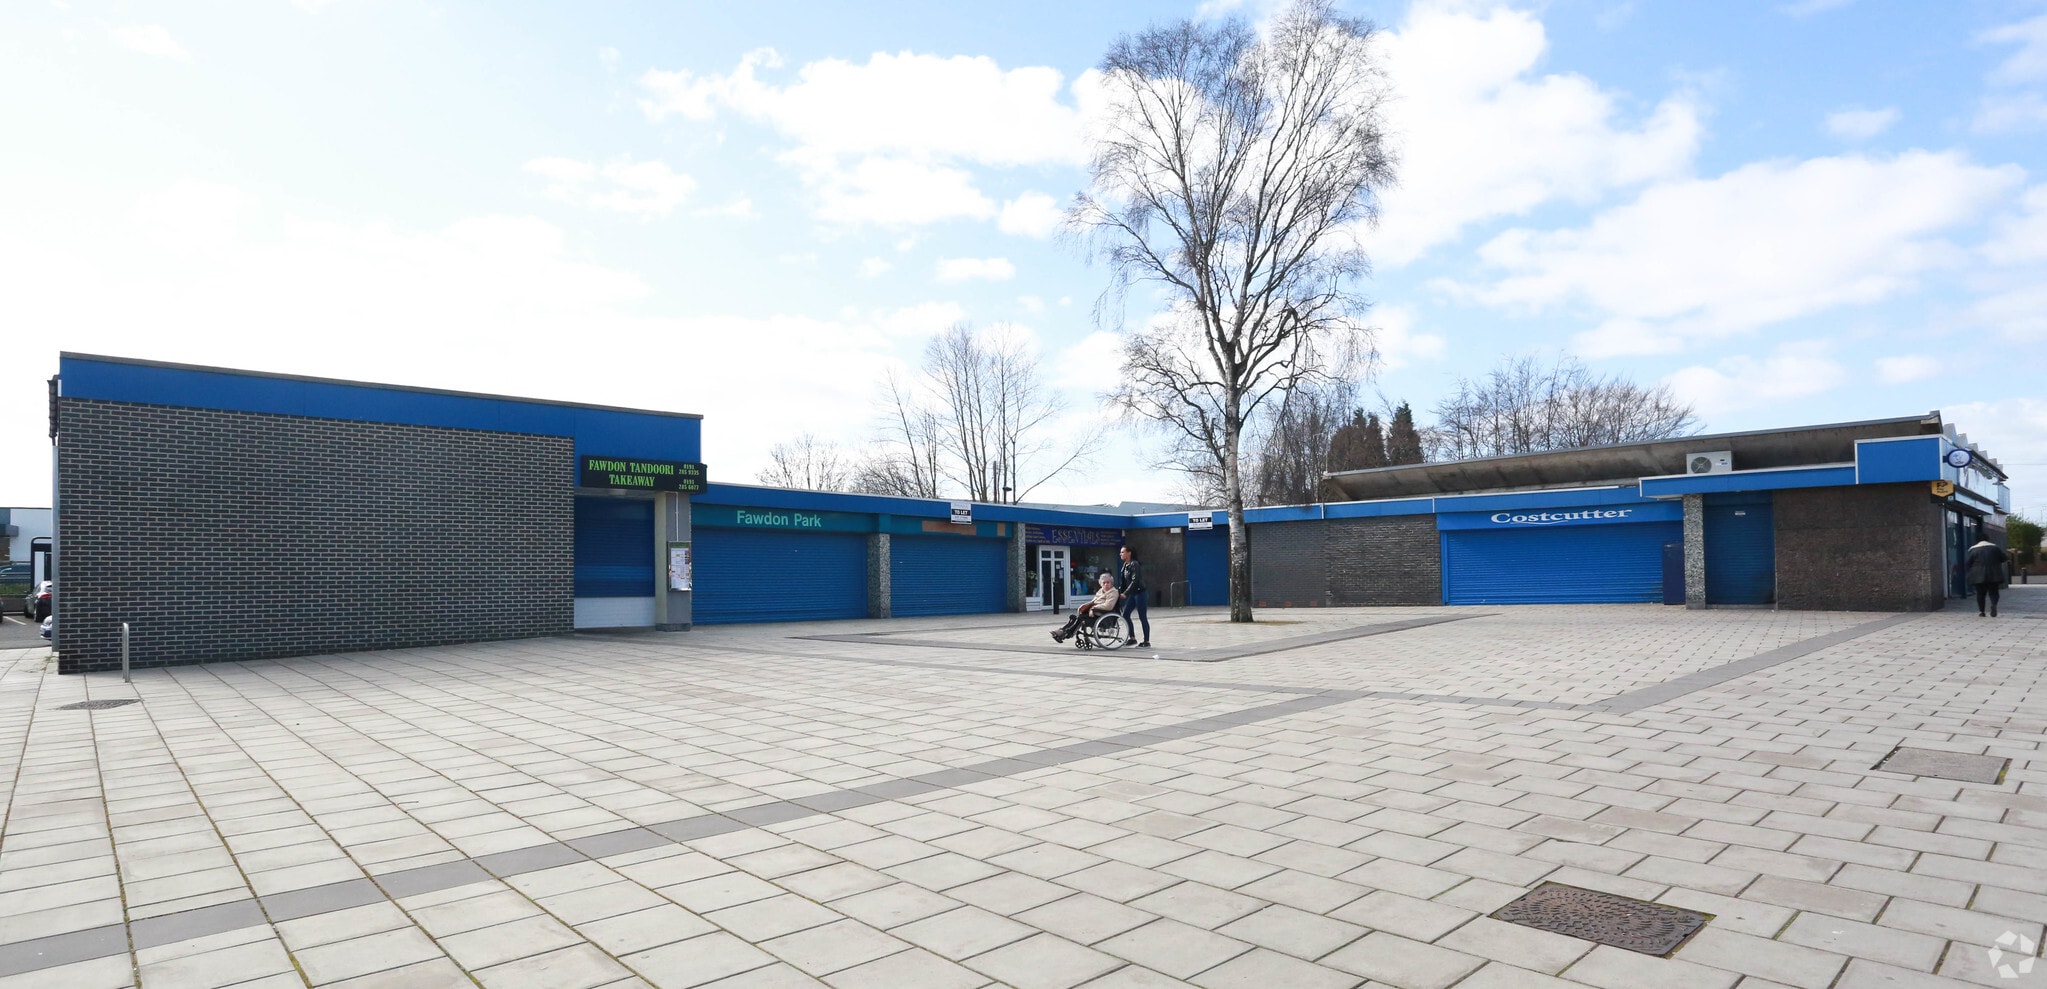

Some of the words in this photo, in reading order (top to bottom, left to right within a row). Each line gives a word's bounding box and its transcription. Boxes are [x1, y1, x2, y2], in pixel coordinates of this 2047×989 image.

[589, 460, 626, 472] FAWDON
[629, 462, 674, 475] TANDOORI
[609, 474, 655, 487] TAKEAWAY
[736, 510, 789, 525] Fawdon
[794, 513, 822, 527] Park
[1490, 509, 1632, 525] Costcutter
